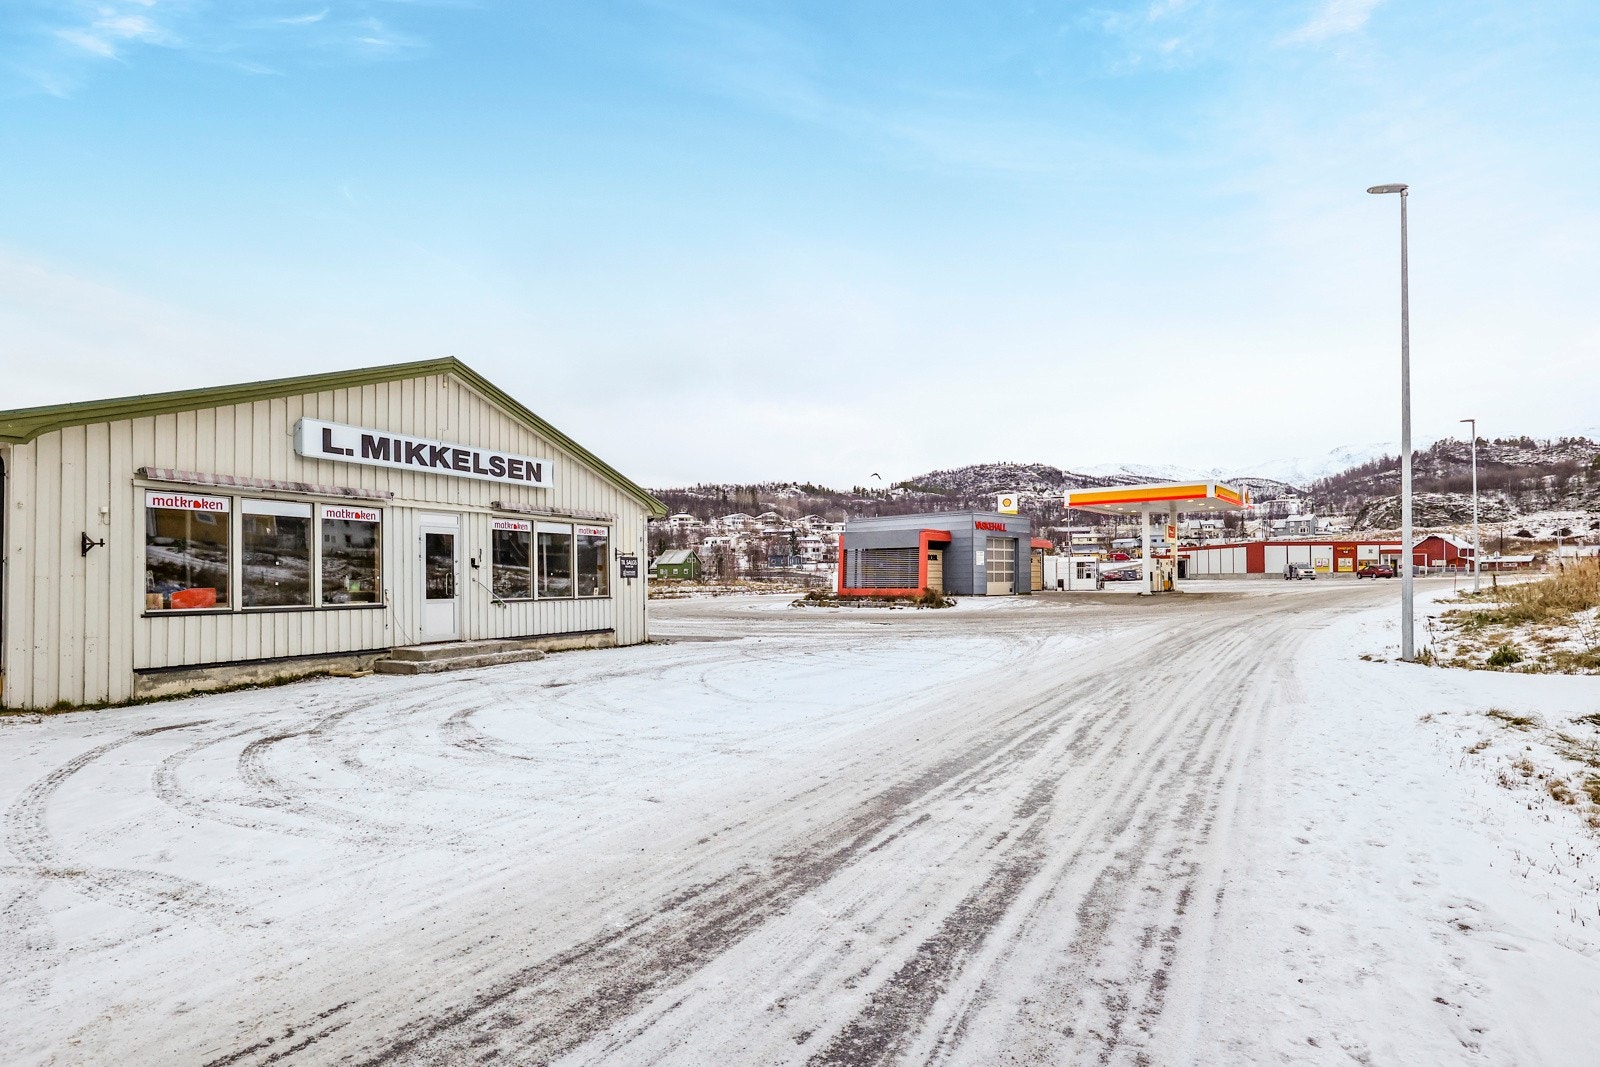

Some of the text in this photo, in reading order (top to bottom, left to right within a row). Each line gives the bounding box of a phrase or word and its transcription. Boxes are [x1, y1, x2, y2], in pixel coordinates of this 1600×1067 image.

[322, 428, 542, 483] L. MIKKELSEN
[975, 521, 1007, 532] VASKEHALL
